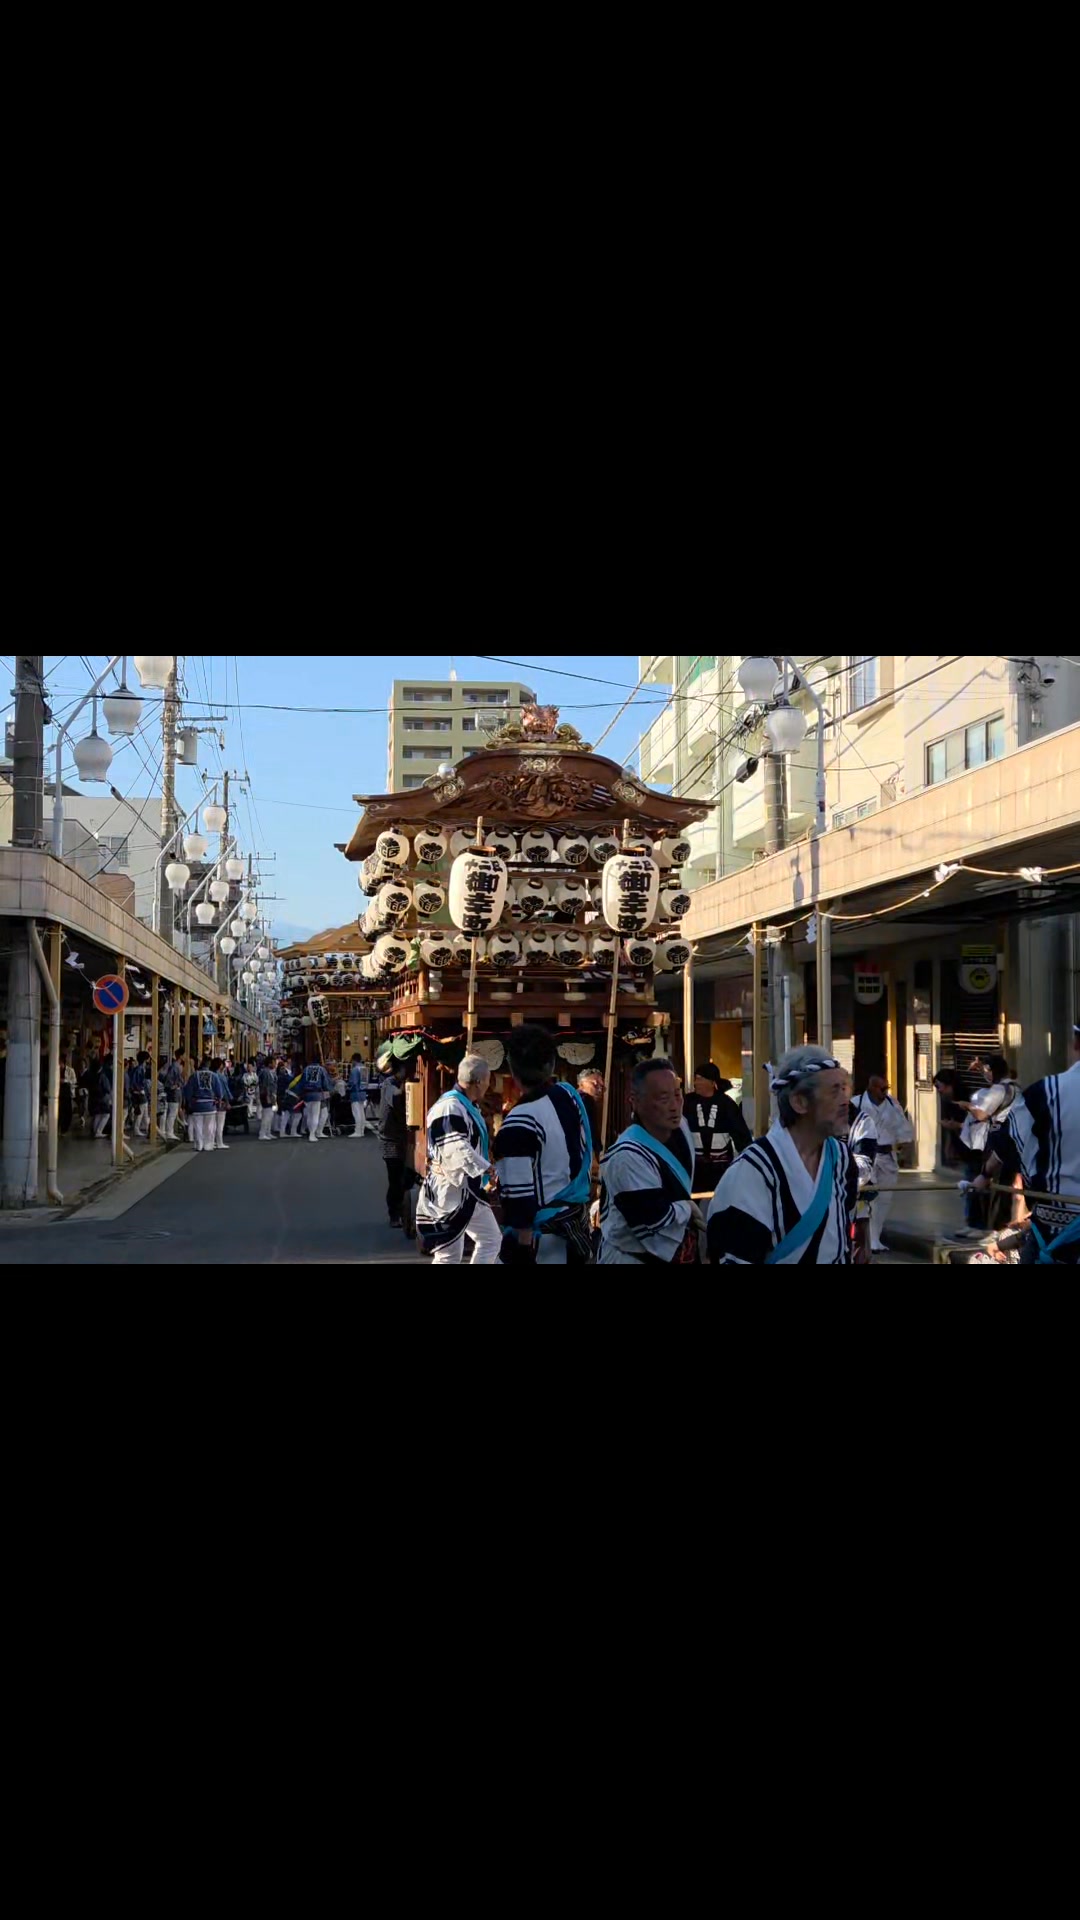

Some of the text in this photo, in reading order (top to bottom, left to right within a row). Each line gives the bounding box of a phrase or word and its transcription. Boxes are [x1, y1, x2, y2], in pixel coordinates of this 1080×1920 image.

[463, 871, 498, 930] 御幸町
[617, 871, 651, 931] 御幸町
